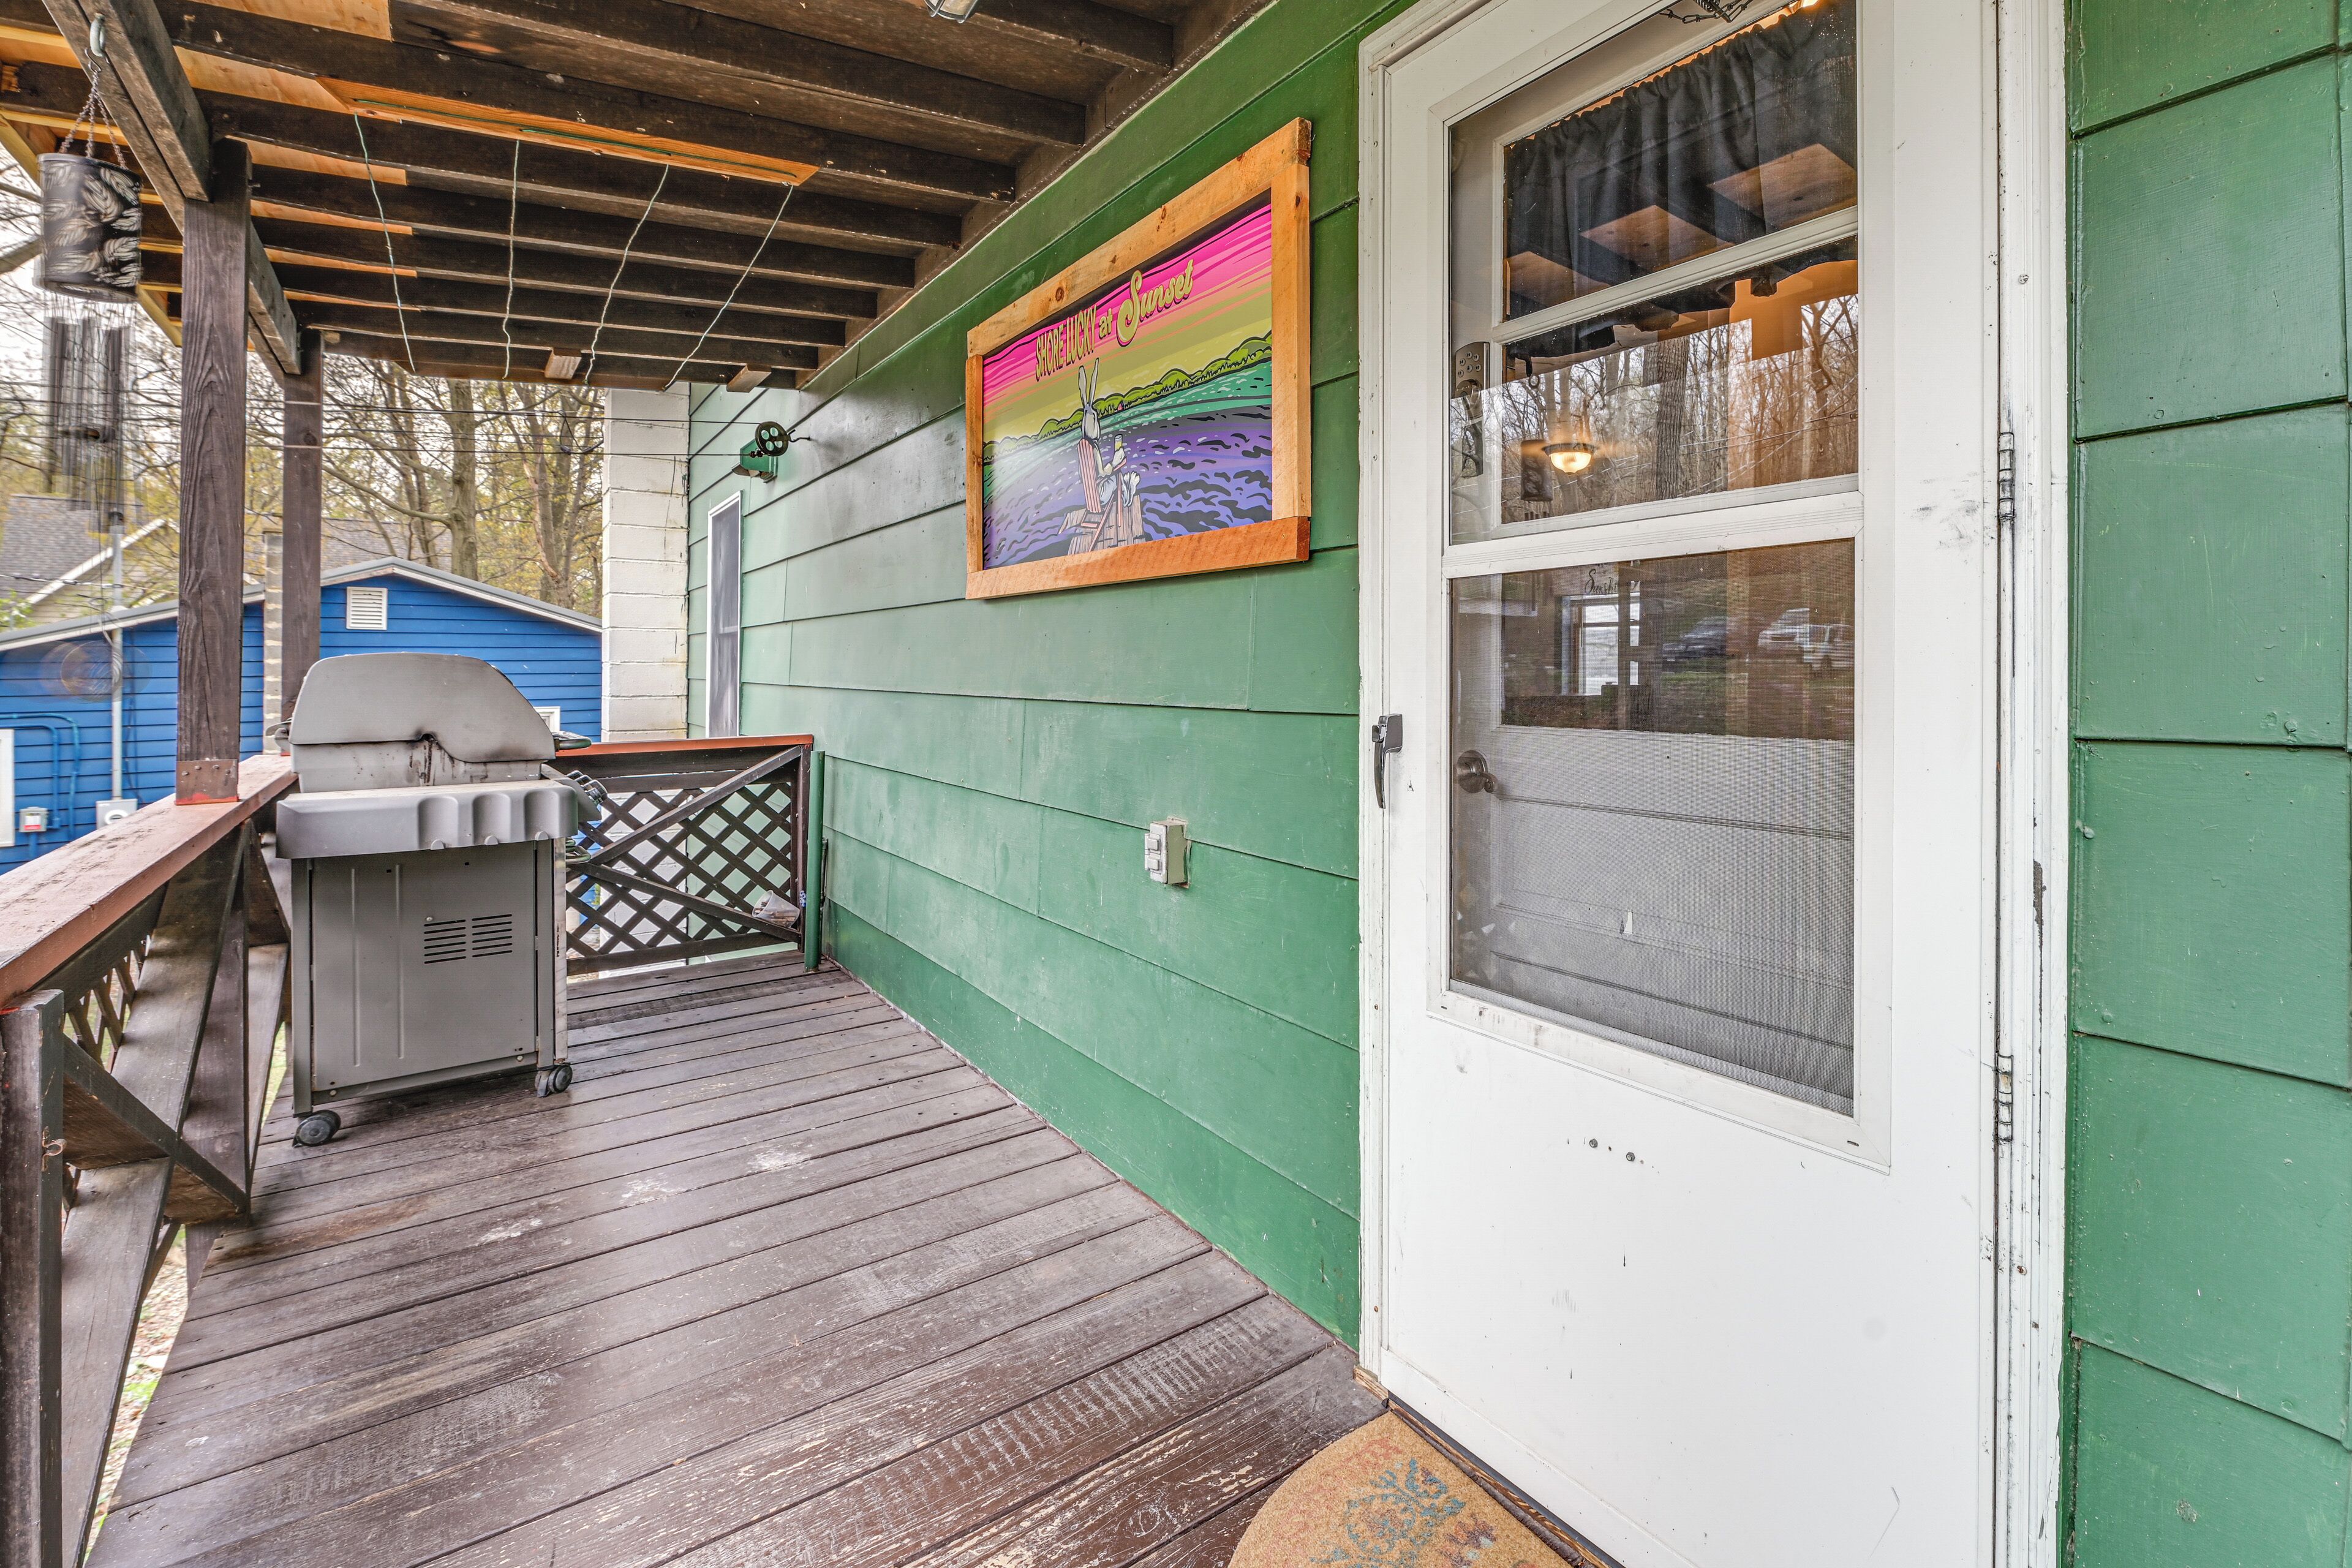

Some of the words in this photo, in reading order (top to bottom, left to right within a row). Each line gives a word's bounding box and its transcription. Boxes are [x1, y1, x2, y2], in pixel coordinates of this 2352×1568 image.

[1036, 323, 1064, 382] SHORE
[1066, 304, 1097, 364] LUCKY
[1098, 307, 1114, 339] at
[1116, 258, 1194, 347] Sunset
[1585, 568, 1619, 595] Sunshi
